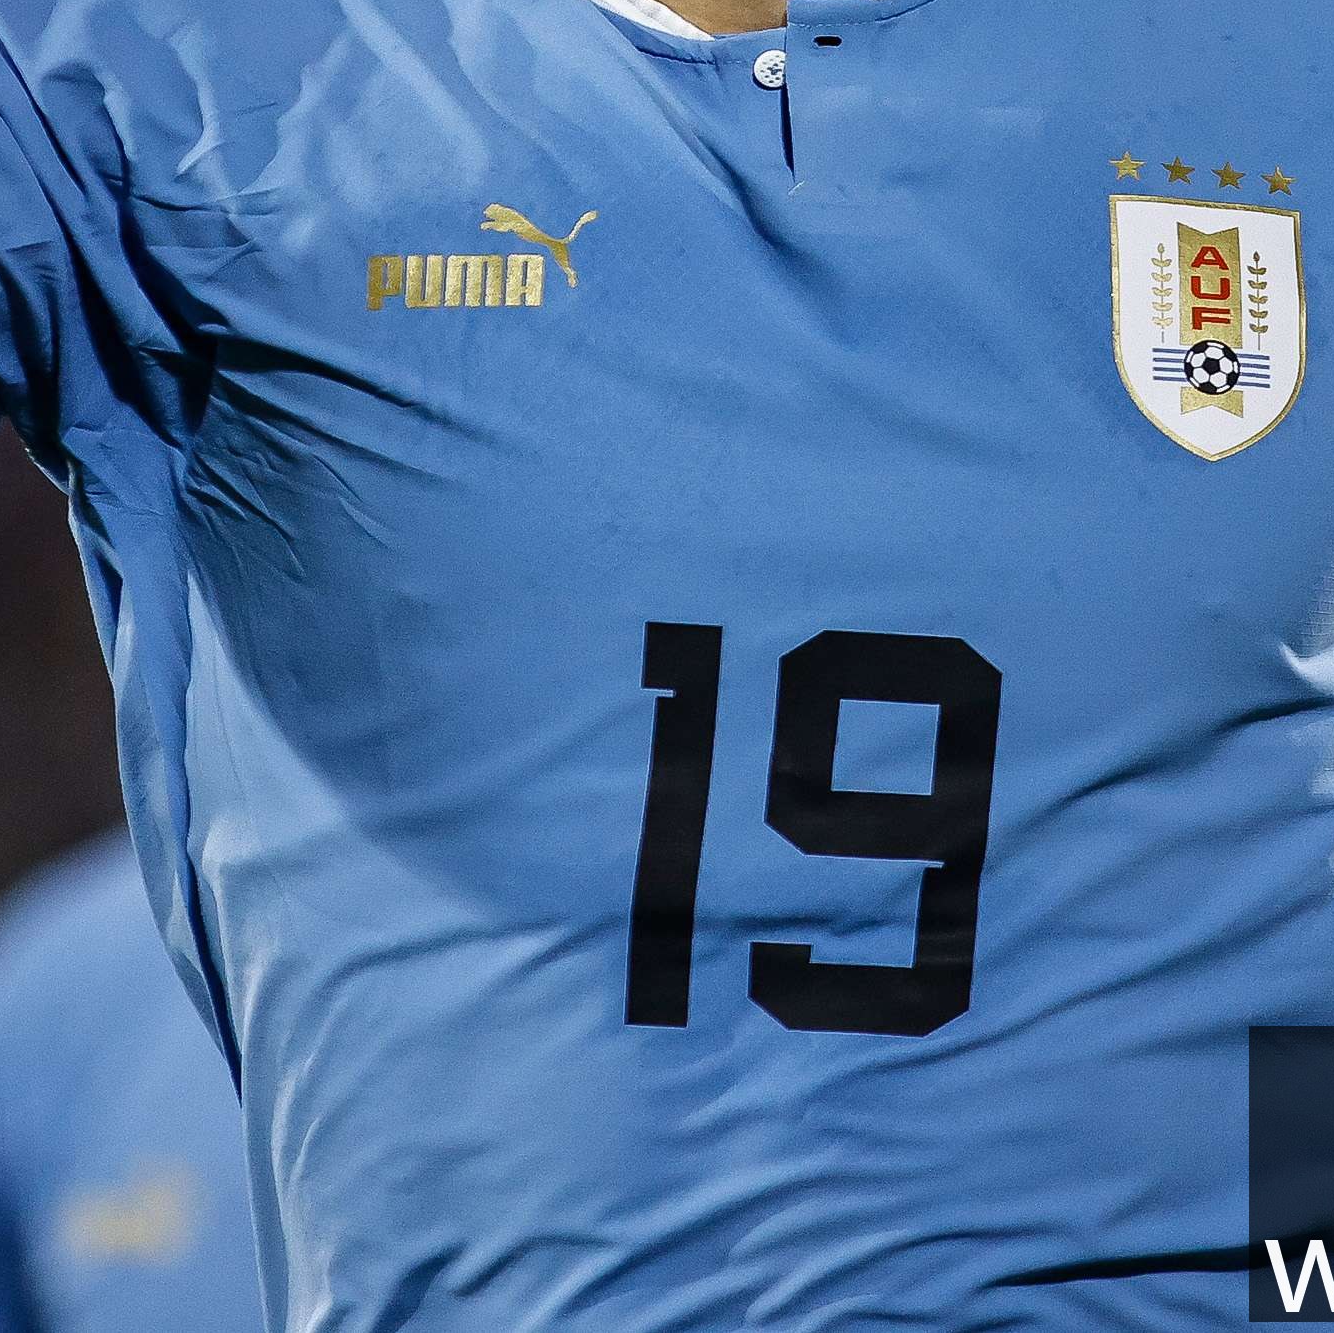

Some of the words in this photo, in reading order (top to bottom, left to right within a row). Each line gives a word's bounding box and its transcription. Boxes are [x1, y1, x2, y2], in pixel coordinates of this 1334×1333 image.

[366, 253, 545, 310] PUMA
[1190, 245, 1232, 331] AUF
[624, 621, 1002, 1038] 19
